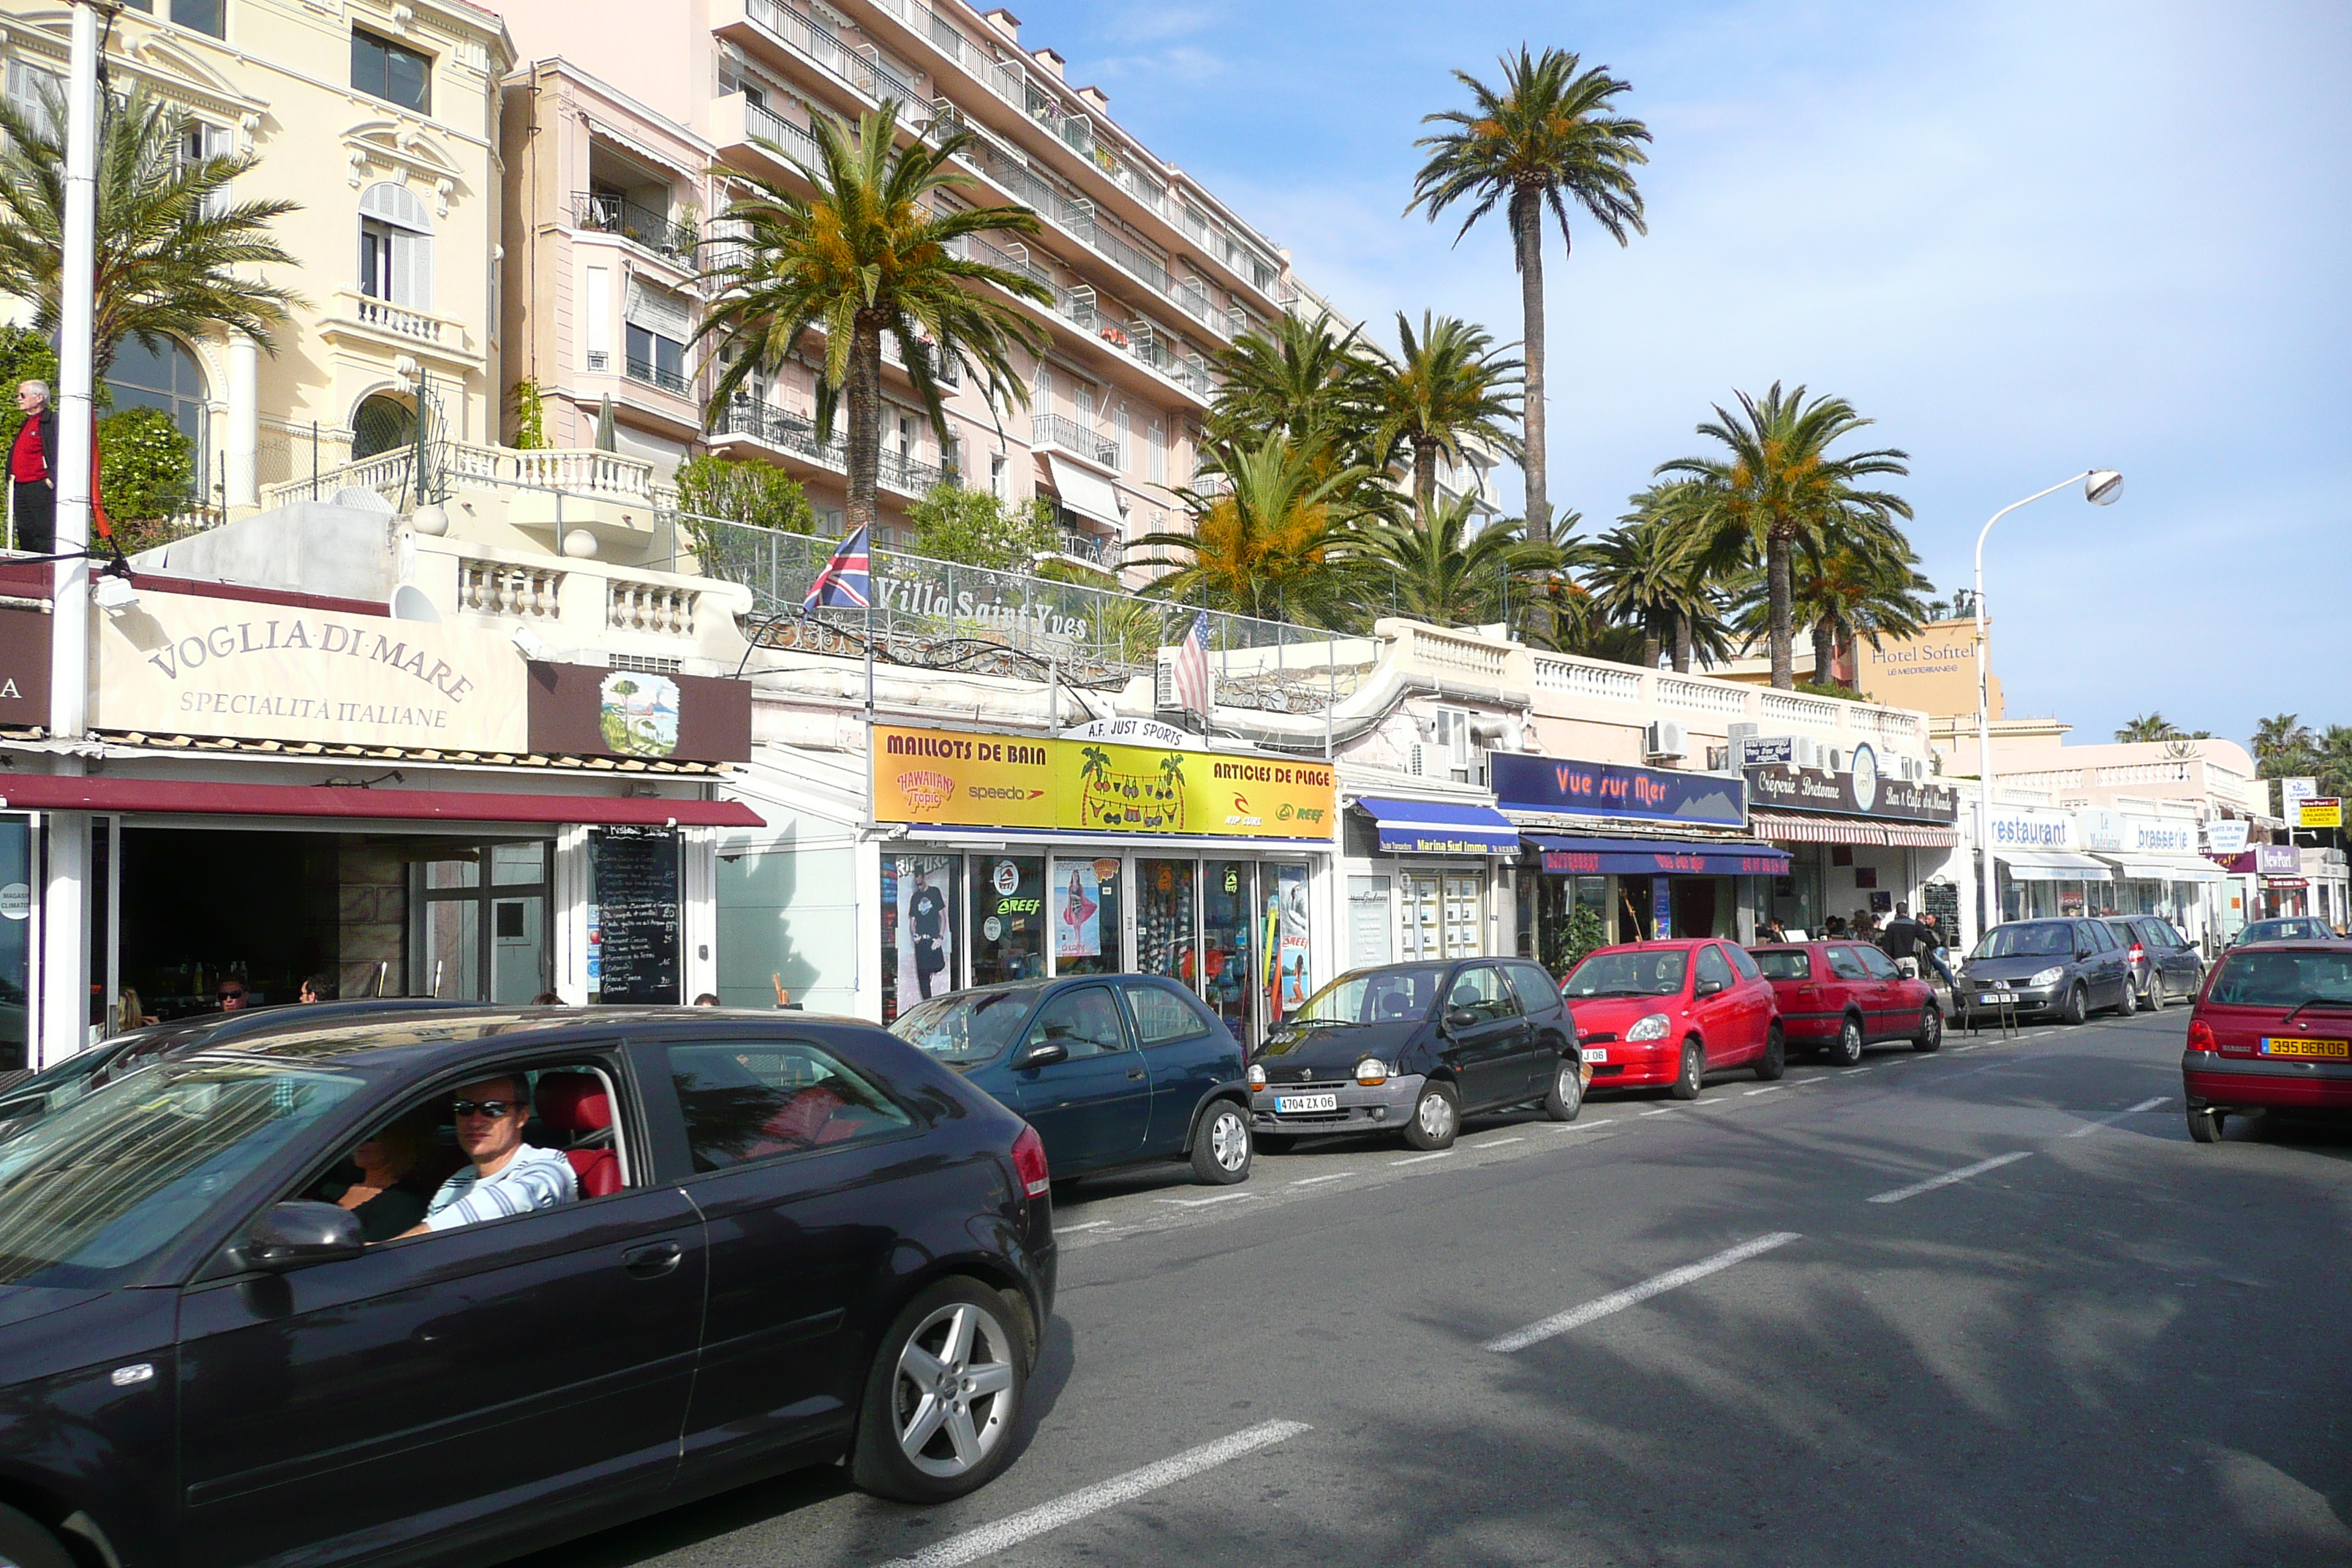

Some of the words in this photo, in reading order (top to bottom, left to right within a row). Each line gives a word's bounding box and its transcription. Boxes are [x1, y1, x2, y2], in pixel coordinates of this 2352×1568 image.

[876, 576, 949, 618] Villa
[956, 591, 1028, 630] Saint
[1035, 603, 1088, 639] Yves
[148, 620, 312, 679] VOGLIA
[319, 623, 364, 657] DI
[369, 633, 474, 704] MARE
[1872, 647, 1918, 664] Hotel
[1922, 643, 1975, 660] Sofitel
[337, 702, 448, 728] ITALIANE
[1110, 720, 1137, 735] JUST
[1143, 723, 1183, 746] SPORTS
[886, 734, 972, 760] MAILLOTS
[978, 742, 1001, 762] DE
[1007, 745, 1047, 766] BAIN
[897, 771, 954, 794] HAWAIIAN
[1213, 762, 1271, 783] ARTICLES
[1275, 768, 1292, 783] DE
[1295, 769, 1330, 787] PLAGE
[1758, 770, 1796, 799] Crêperie
[1801, 776, 1839, 799] Bretonne
[907, 788, 939, 806] Tropic
[968, 785, 1025, 800] speedo
[1556, 765, 1593, 797] Vue
[1599, 774, 1629, 797] sur
[1635, 773, 1666, 807] Mer
[1886, 786, 1899, 805] Bar
[1907, 791, 1921, 813] Café
[1932, 793, 1952, 811] Monde
[1224, 815, 1241, 825] RIP
[1242, 816, 1262, 826] CURL
[1296, 807, 1324, 823] REEF
[2100, 813, 2109, 830] Le
[1991, 815, 2067, 843] restaurant
[2138, 824, 2188, 849] brasserie
[1417, 839, 1446, 851] Marina
[1447, 840, 1463, 851] Sud
[1464, 841, 1488, 853] Immo
[2264, 851, 2291, 867] NewPort
[1010, 900, 1040, 915] REEF
[1593, 1051, 1603, 1060] 06
[2273, 1040, 2298, 1053] 395
[2328, 1042, 2345, 1055] 06
[1282, 1098, 1304, 1109] 4704
[1306, 1098, 1319, 1109] ZX
[1321, 1097, 1333, 1107] 06
